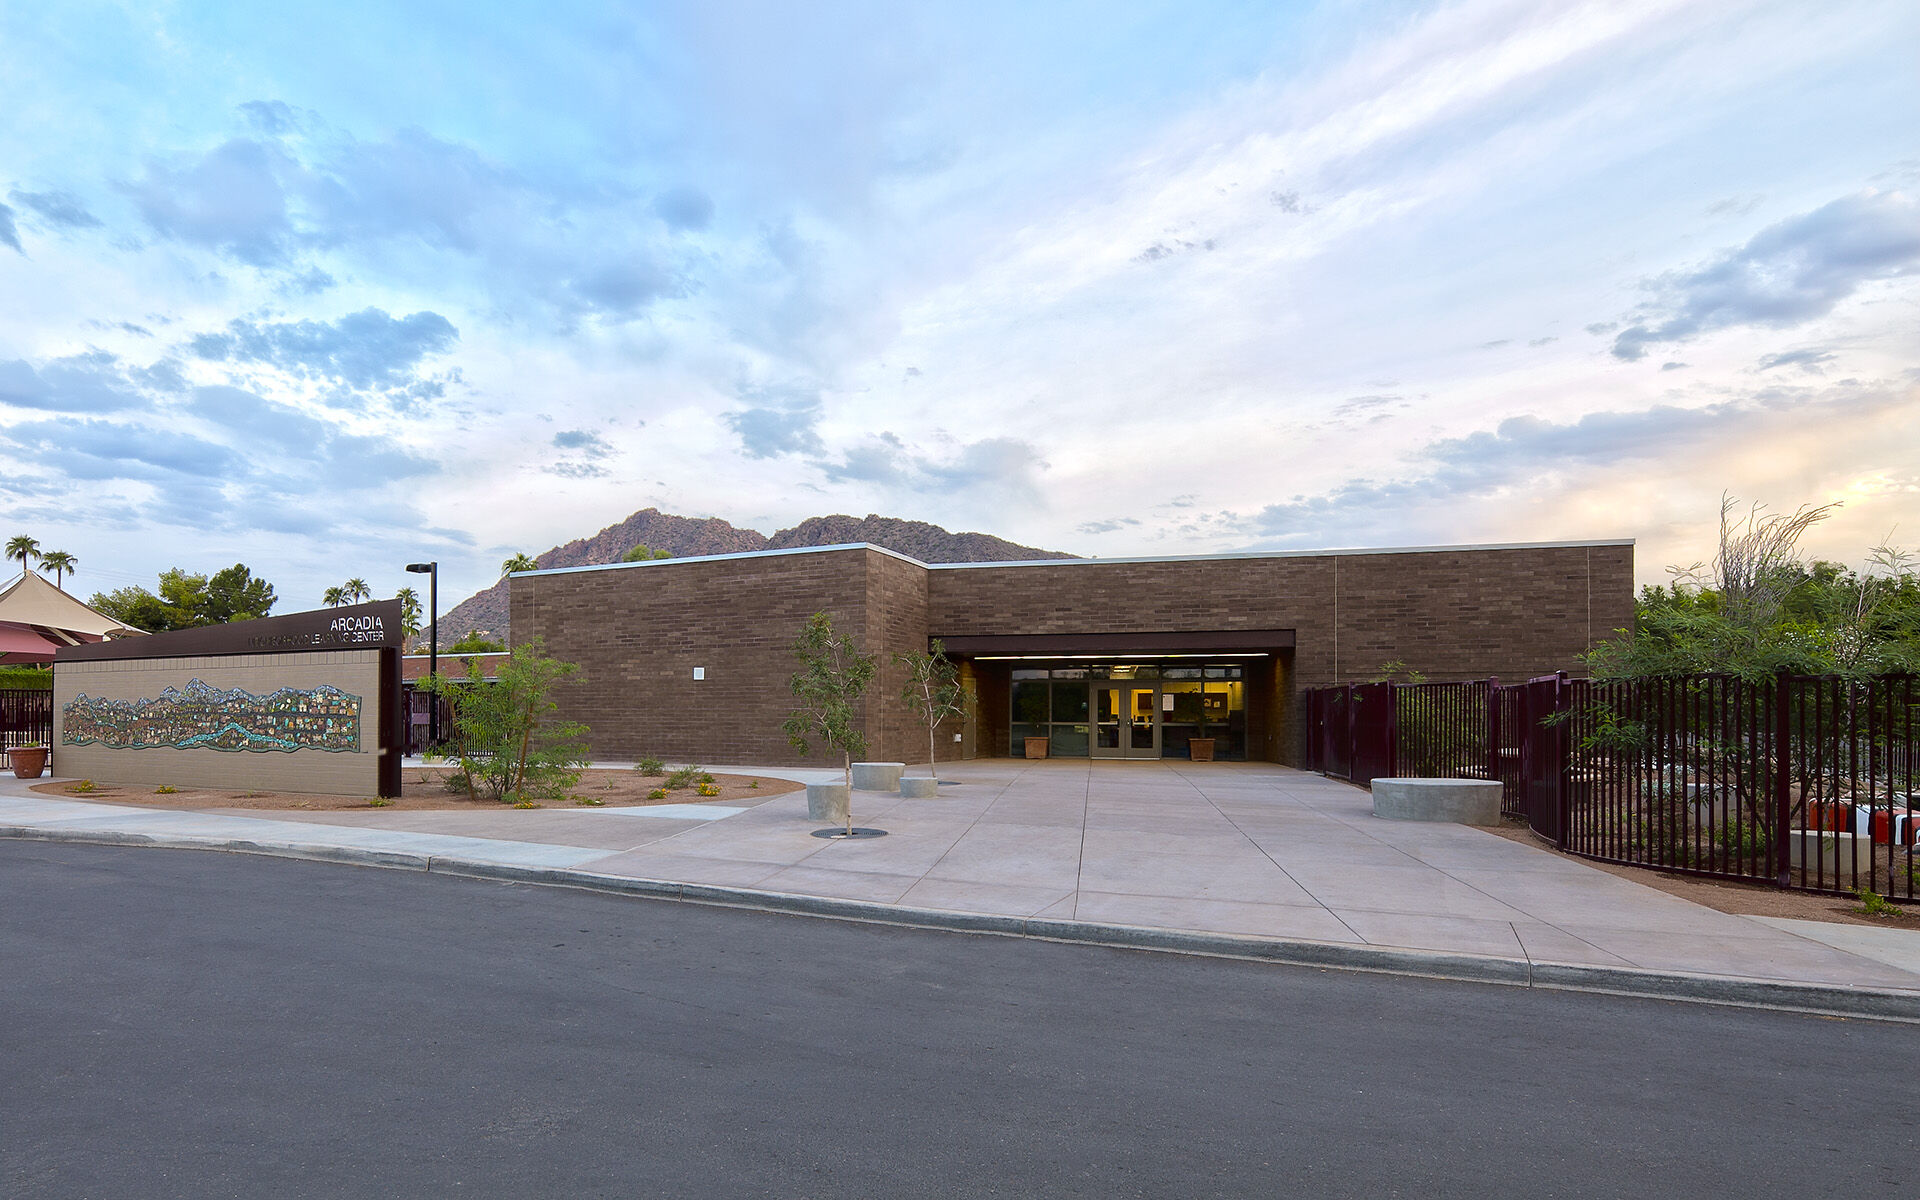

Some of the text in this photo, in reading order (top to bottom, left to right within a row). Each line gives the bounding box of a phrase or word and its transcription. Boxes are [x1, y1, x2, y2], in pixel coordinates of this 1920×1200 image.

[331, 616, 383, 631] ARCADIA
[311, 632, 349, 644] LEARNNG
[352, 631, 384, 643] CENTER
